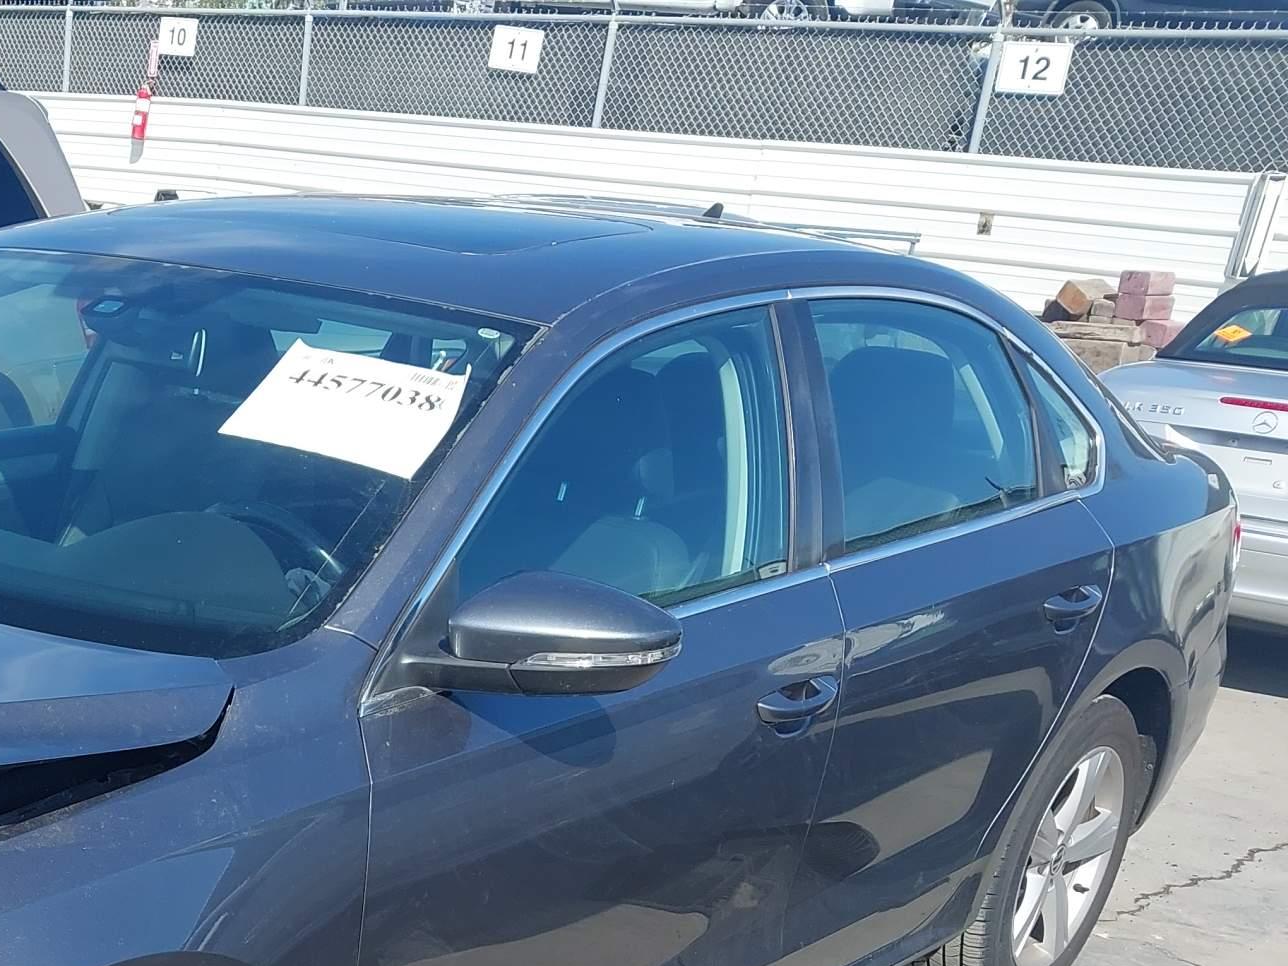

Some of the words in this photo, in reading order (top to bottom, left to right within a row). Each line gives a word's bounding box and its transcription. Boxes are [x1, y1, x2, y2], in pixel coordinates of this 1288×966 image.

[169, 26, 187, 46] 10
[507, 38, 528, 61] 11
[1019, 55, 1051, 80] 12
[288, 369, 442, 412] 44577038
